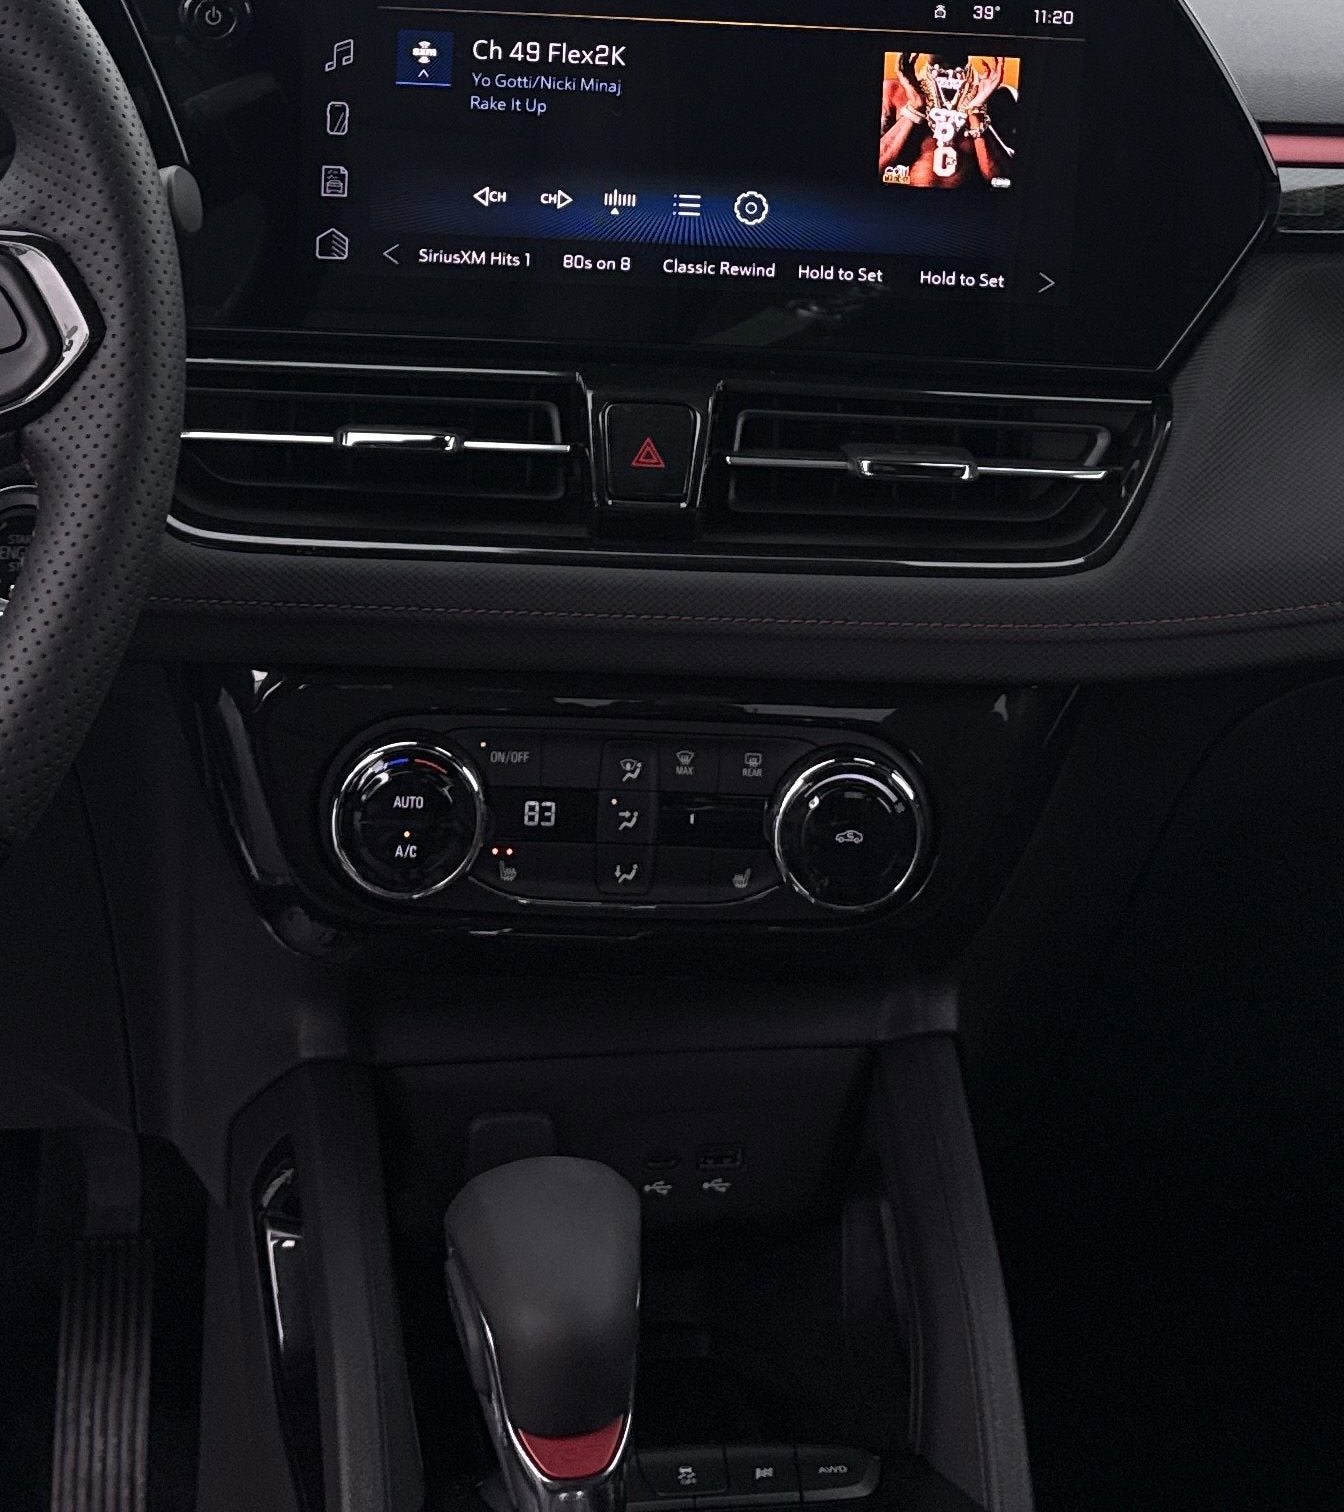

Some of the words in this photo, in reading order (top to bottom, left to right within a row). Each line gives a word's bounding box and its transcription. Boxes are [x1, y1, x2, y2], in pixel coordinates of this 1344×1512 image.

[972, 5, 1001, 20] 39°
[1034, 9, 1074, 25] 11:20
[472, 39, 502, 61] Ch
[509, 41, 541, 62] 49
[548, 42, 627, 67] Flex2K
[472, 72, 491, 88] Yo
[495, 74, 576, 92] Gotti/Nicki
[581, 78, 622, 96] Minaj
[470, 95, 506, 112] Rake
[511, 97, 522, 112] It
[526, 98, 548, 116] Up
[489, 191, 506, 203] CH
[540, 193, 557, 205] CH
[418, 248, 486, 265] SiriusXM
[490, 251, 520, 266] Hits
[524, 252, 531, 267] 1
[563, 254, 593, 270] 80s
[596, 259, 616, 271] on
[620, 257, 631, 271] 8
[662, 258, 716, 276] Classic
[720, 261, 776, 278] Rewind
[798, 264, 834, 281] Hold
[837, 267, 854, 282] to
[858, 267, 883, 283] Set
[920, 270, 956, 286] Hold
[959, 272, 976, 287] to
[979, 273, 1004, 288] Set
[490, 750, 530, 764] ON/OFF
[676, 766, 694, 776] MAX
[742, 768, 763, 778] REAR
[392, 795, 424, 810] AUTO
[524, 800, 556, 827] 83
[394, 843, 418, 858] A/C
